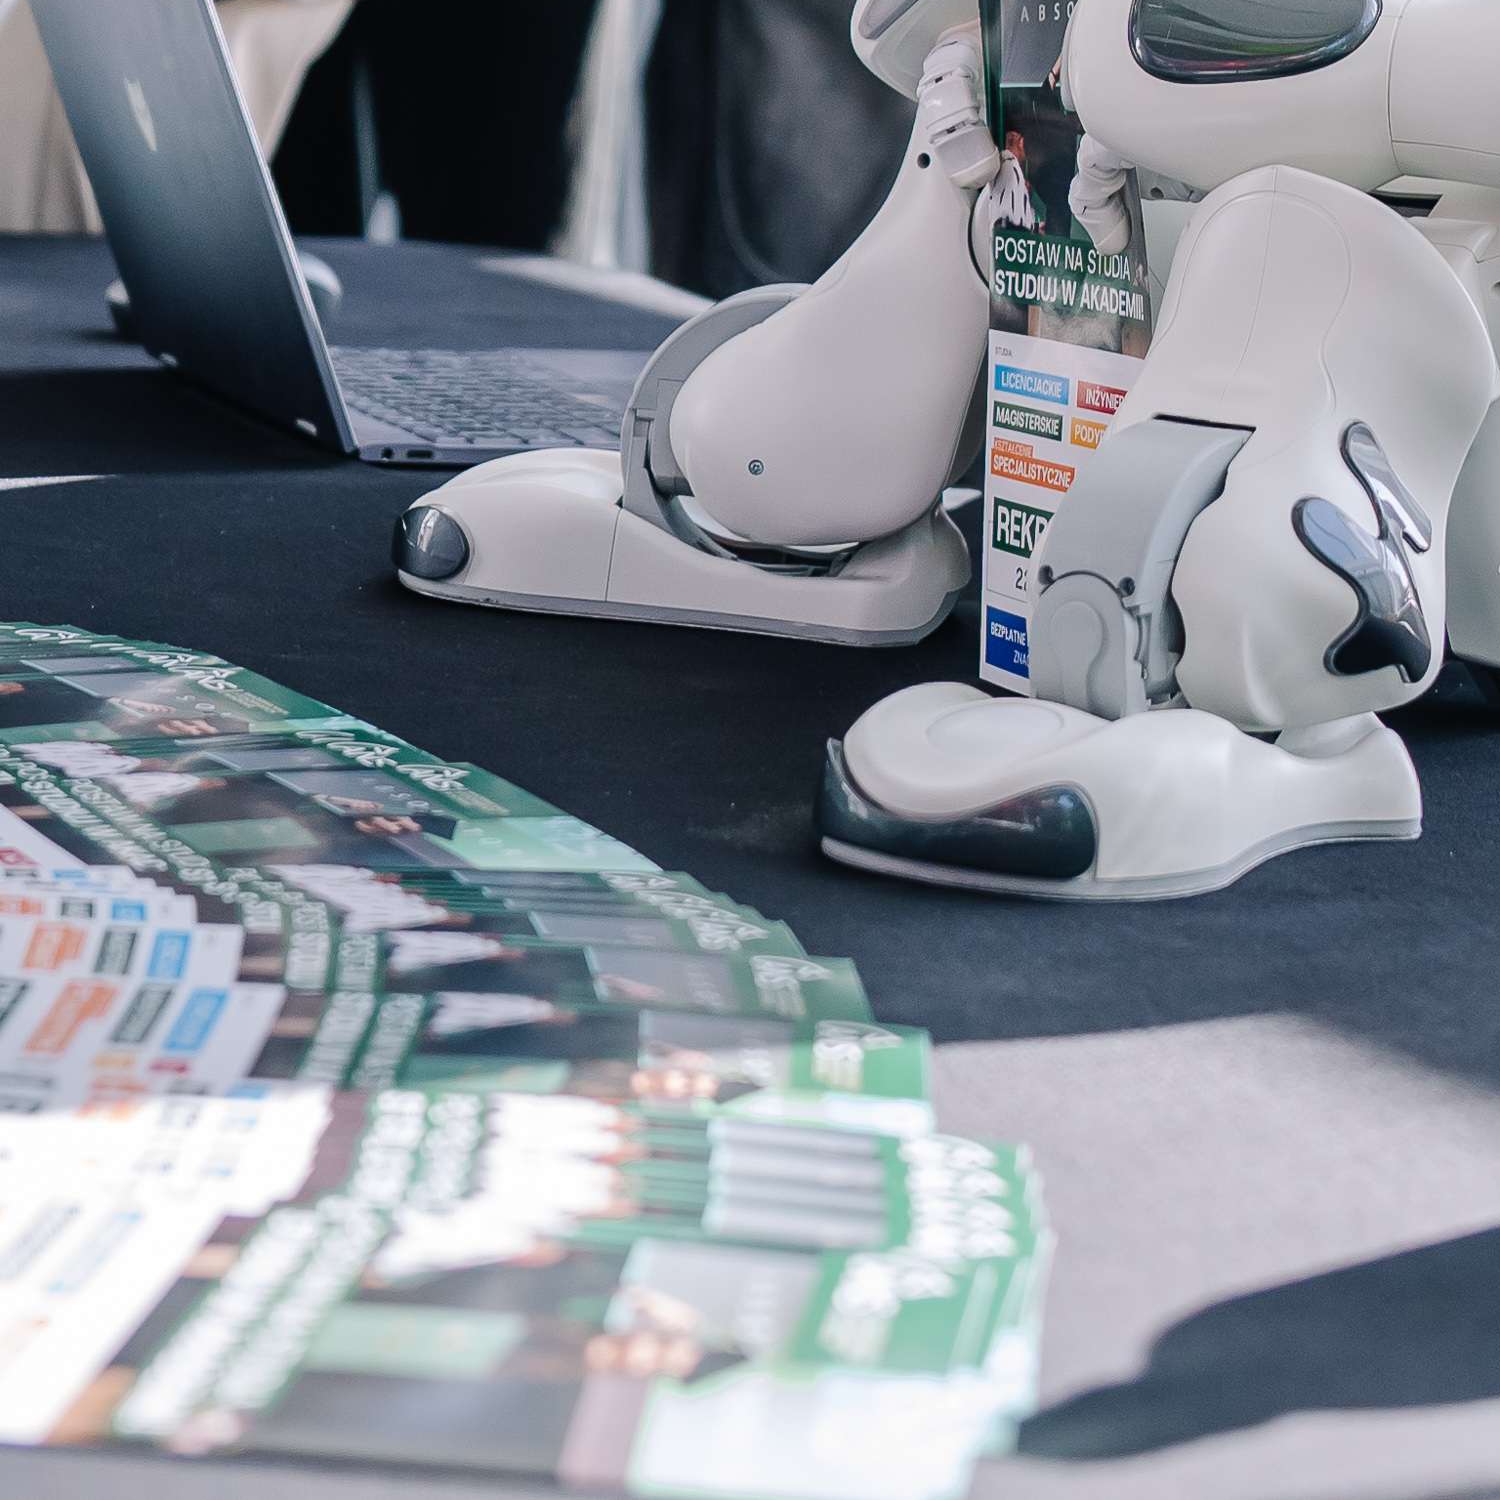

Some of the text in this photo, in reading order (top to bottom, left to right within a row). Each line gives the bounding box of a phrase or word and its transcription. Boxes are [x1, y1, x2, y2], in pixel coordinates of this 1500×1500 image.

[995, 236, 1131, 281] POSTAW NA STUDIA
[995, 269, 1145, 321] STUDIUJ W AKADEMII!
[1001, 370, 1063, 398] LICENCJACKIE
[996, 406, 1060, 435] MAGISTERSKIE
[993, 454, 1072, 487] SPECJALISTYCZNE
[990, 621, 1026, 646] BEZPŁATNE
